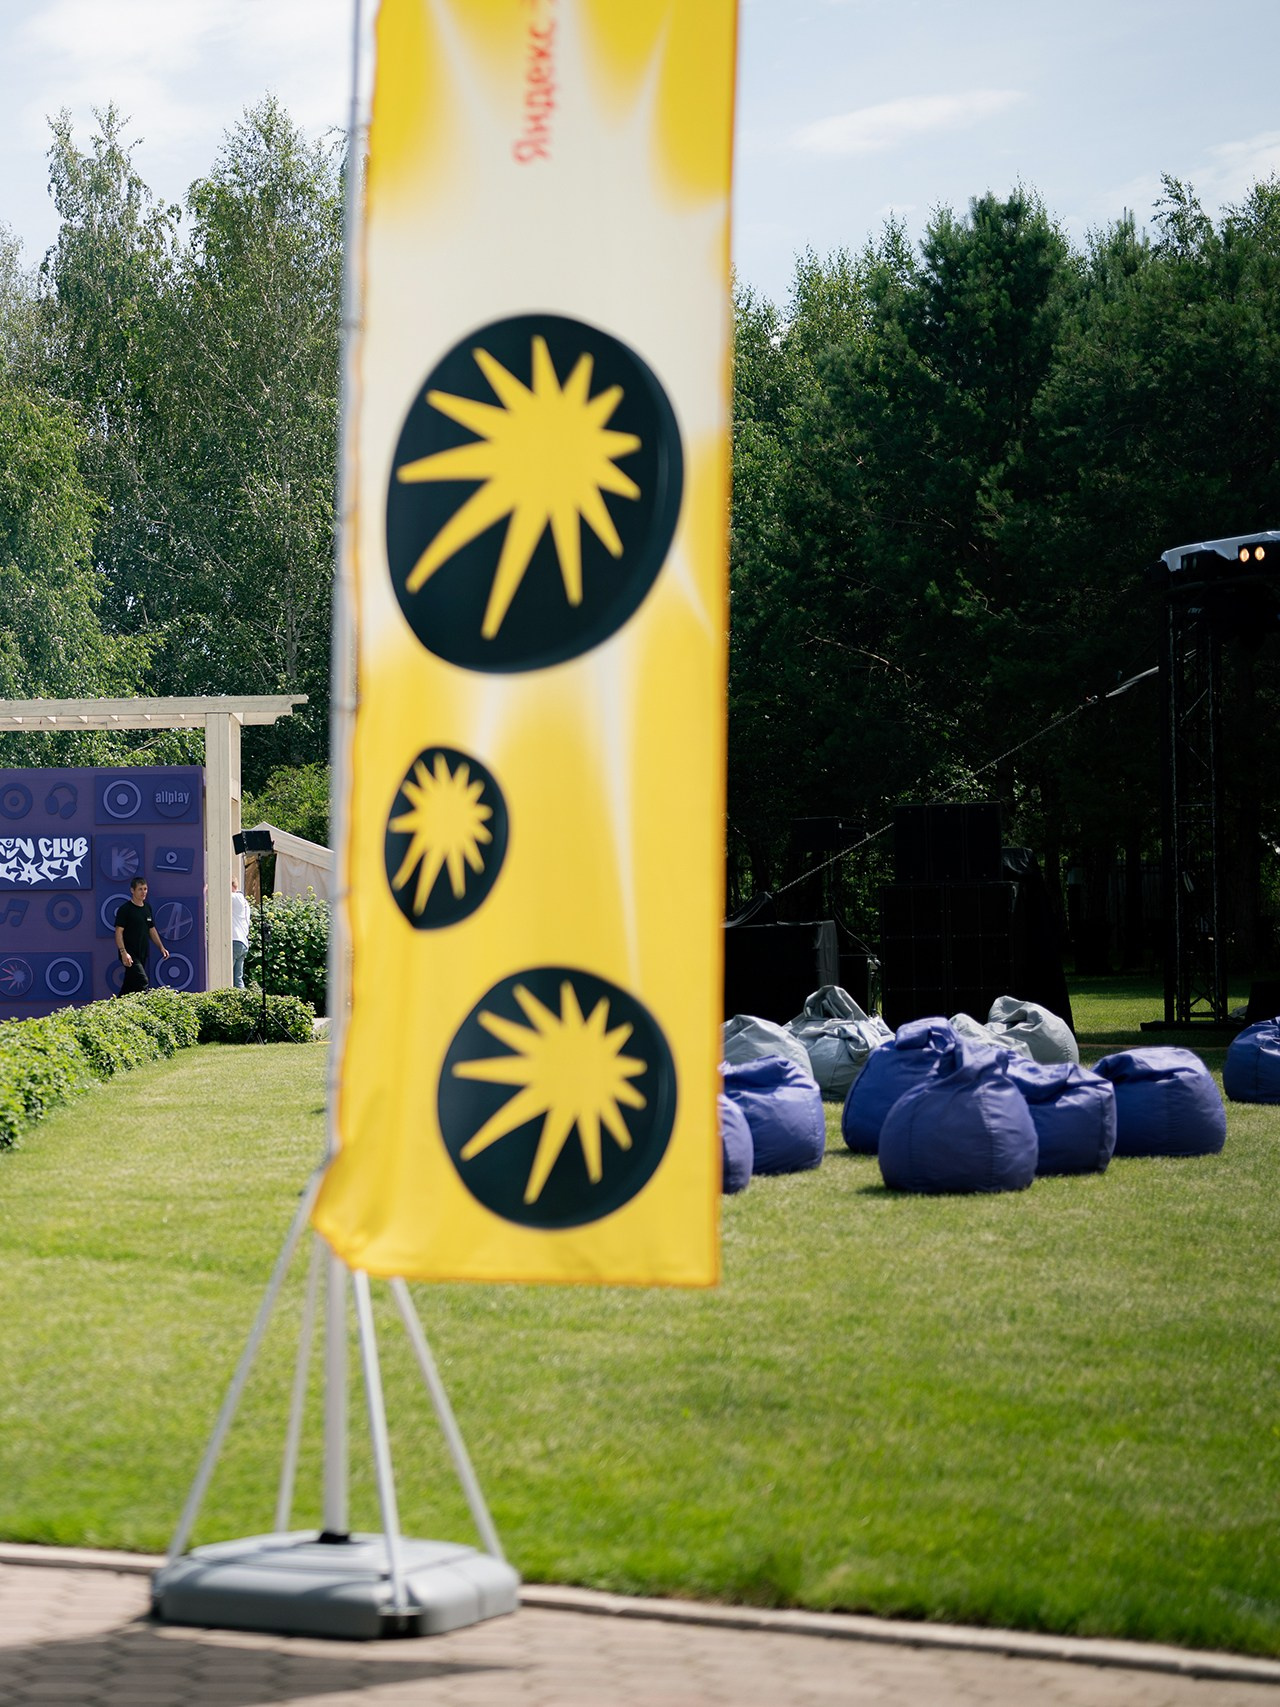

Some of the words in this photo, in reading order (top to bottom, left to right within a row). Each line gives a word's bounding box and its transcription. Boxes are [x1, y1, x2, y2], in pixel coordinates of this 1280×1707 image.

[512, 18, 558, 165] Яндекс
[155, 790, 190, 805] allplay
[38, 837, 88, 857] CLUB
